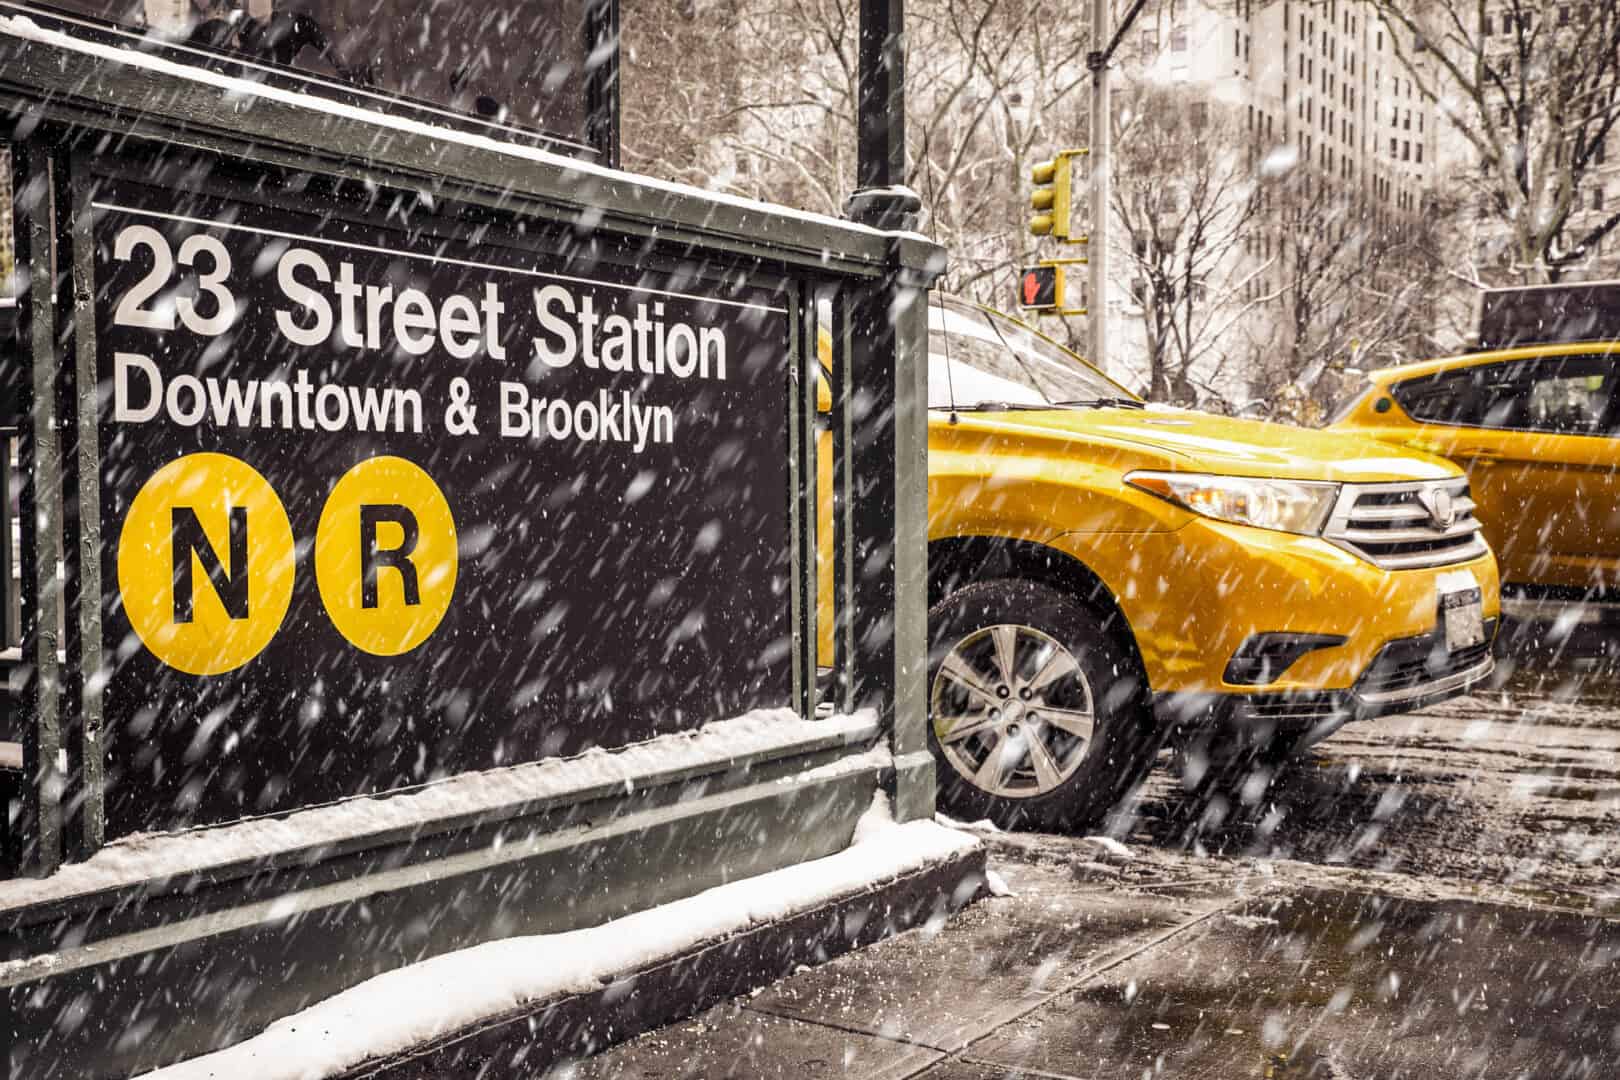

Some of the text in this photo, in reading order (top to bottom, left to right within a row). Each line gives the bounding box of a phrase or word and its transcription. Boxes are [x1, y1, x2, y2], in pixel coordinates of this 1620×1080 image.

[113, 225, 727, 380] 23 Street Station
[114, 352, 674, 453] Downtown & Brooklyn
[172, 504, 420, 624] N R
